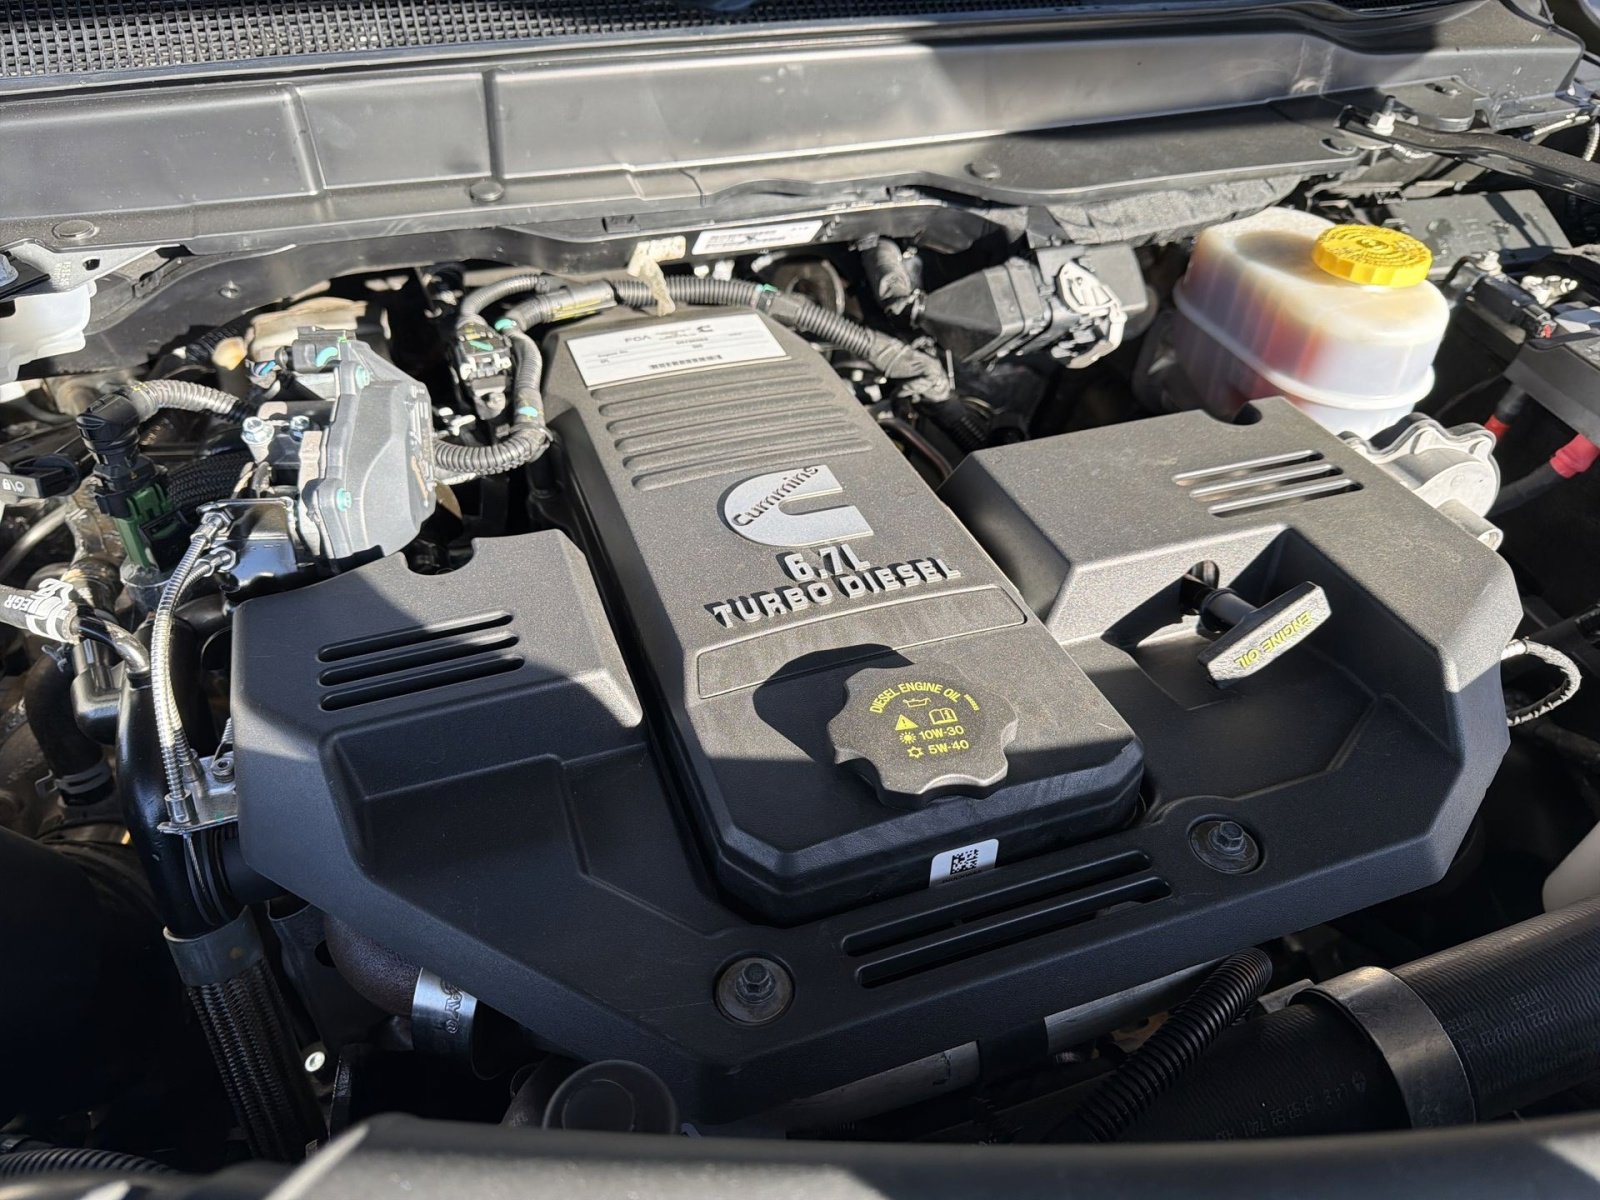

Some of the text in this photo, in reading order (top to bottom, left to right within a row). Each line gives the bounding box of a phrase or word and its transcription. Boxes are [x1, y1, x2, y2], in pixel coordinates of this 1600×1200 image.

[731, 465, 819, 526] Cummins
[783, 543, 871, 583] 6.7L
[4, 594, 34, 611] EGR
[712, 557, 962, 628] TURBO DIESEL
[1234, 610, 1313, 670] ENGINE OIL
[869, 687, 900, 714] DIESEL
[897, 681, 944, 695] ENGINE
[943, 688, 961, 703] OIL
[919, 725, 965, 740] 10W-30
[928, 739, 970, 754] 5W-40
